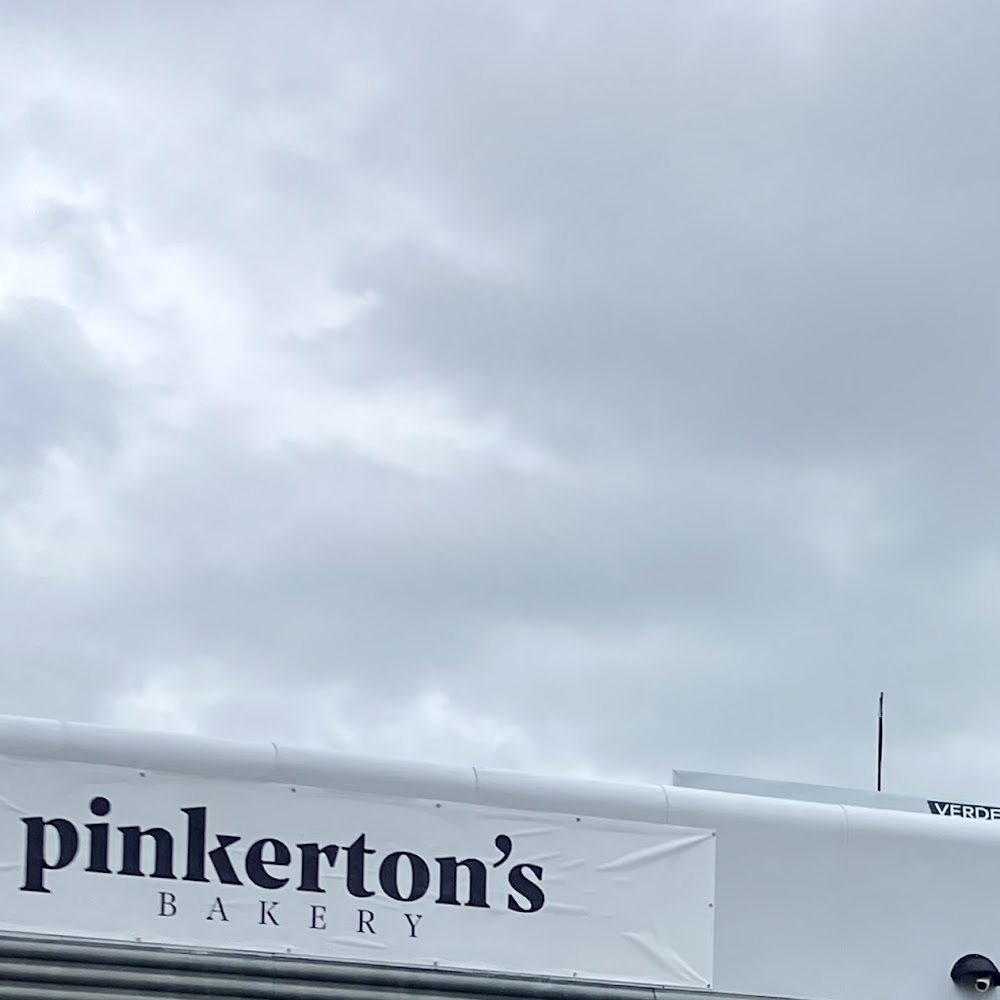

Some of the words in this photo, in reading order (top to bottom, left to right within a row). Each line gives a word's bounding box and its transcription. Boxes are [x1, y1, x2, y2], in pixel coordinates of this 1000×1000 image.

[934, 802, 1000, 820] VERDE
[19, 796, 546, 914] pinkerton’s
[158, 891, 423, 938] BAKERY
